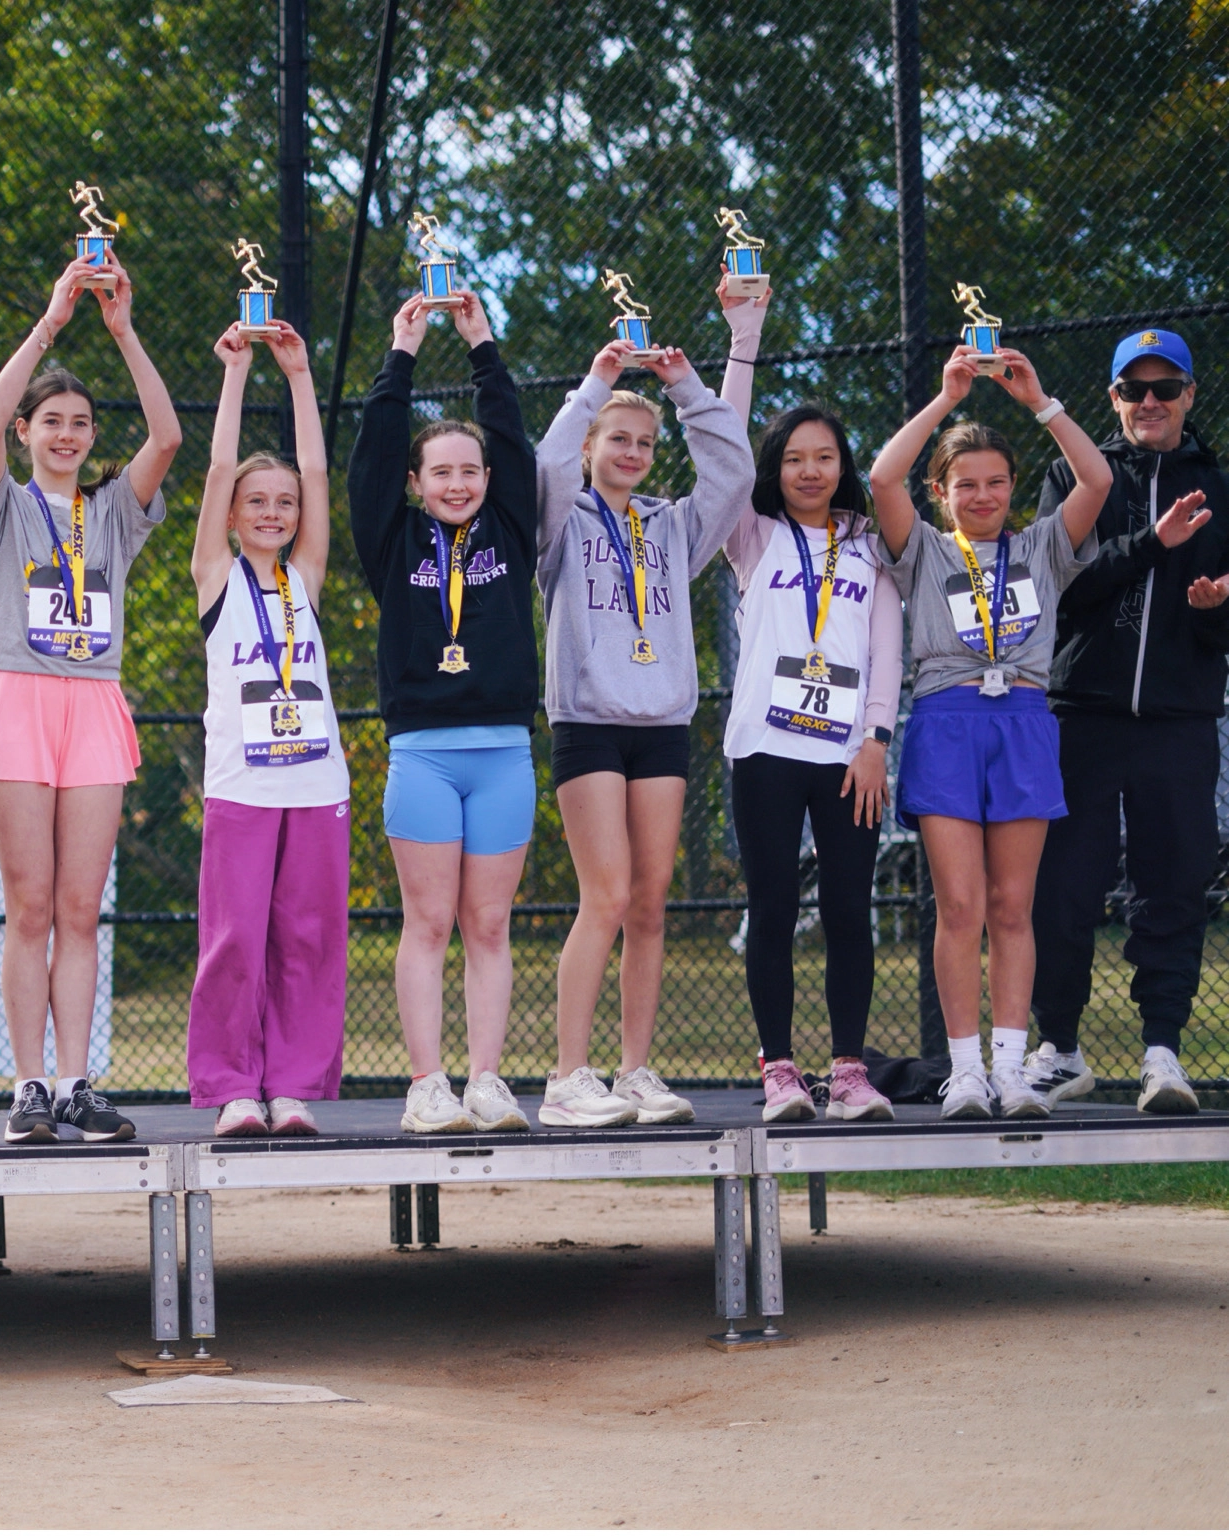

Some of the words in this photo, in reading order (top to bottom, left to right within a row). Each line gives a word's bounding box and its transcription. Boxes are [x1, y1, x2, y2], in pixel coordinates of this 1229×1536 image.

[73, 522, 83, 559] MSXC
[634, 535, 645, 570] MSXC
[417, 546, 496, 576] LIN
[452, 542, 463, 574] MSXC
[824, 548, 837, 585] MSXC
[969, 566, 986, 599] MSXC
[49, 592, 93, 627] 249
[283, 600, 294, 636] MSXC
[31, 633, 52, 641] B.A.A.
[53, 631, 91, 645] MS
[962, 633, 983, 642] B.A.A.
[991, 621, 1023, 637] SXC
[799, 683, 830, 715] 78
[770, 710, 790, 721] B.A.A.
[790, 713, 831, 731] MSXC
[830, 726, 848, 735] 2026
[247, 748, 269, 756] B.A.A.
[269, 742, 310, 756] MSXC
[310, 743, 327, 751] 2026
